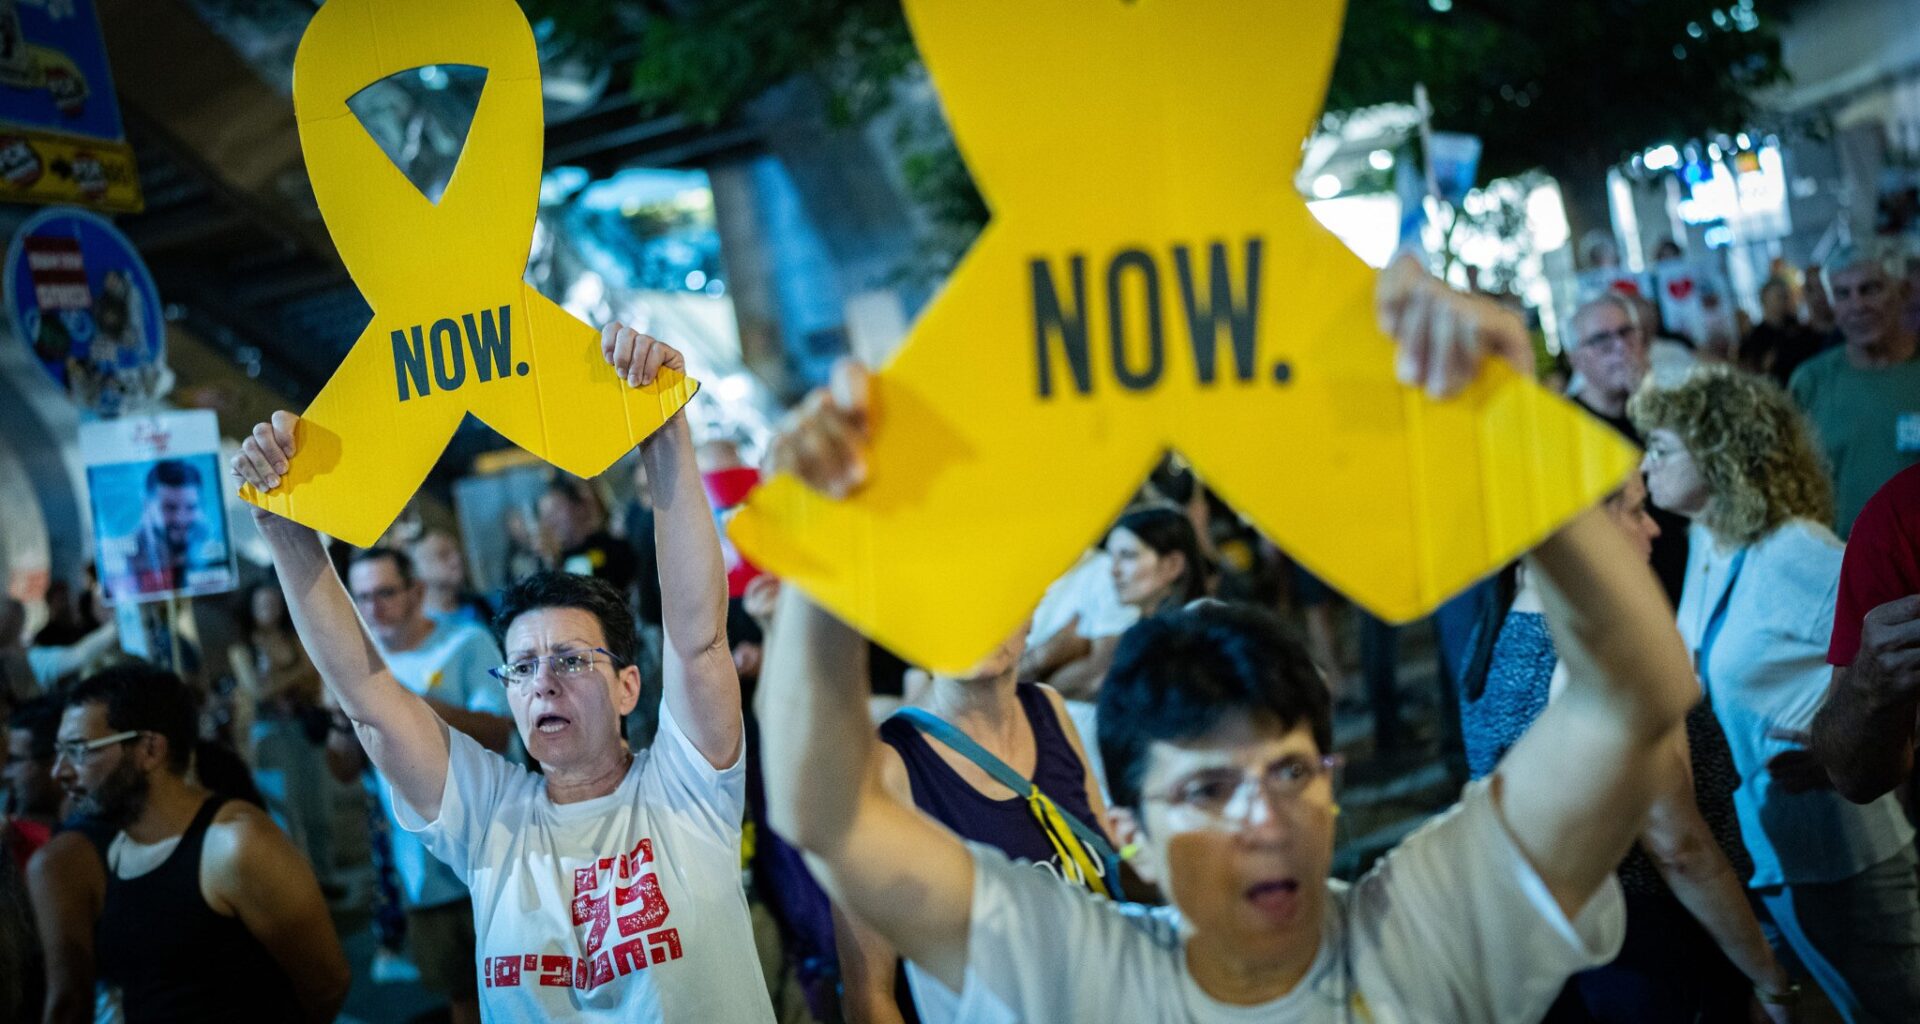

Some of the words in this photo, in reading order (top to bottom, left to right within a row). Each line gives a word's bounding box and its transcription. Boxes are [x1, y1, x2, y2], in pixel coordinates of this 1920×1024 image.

[390, 304, 530, 402] NOW.
[1029, 239, 1292, 397] NOW.
[485, 927, 683, 991] החטופים!
[571, 872, 671, 957] כל
